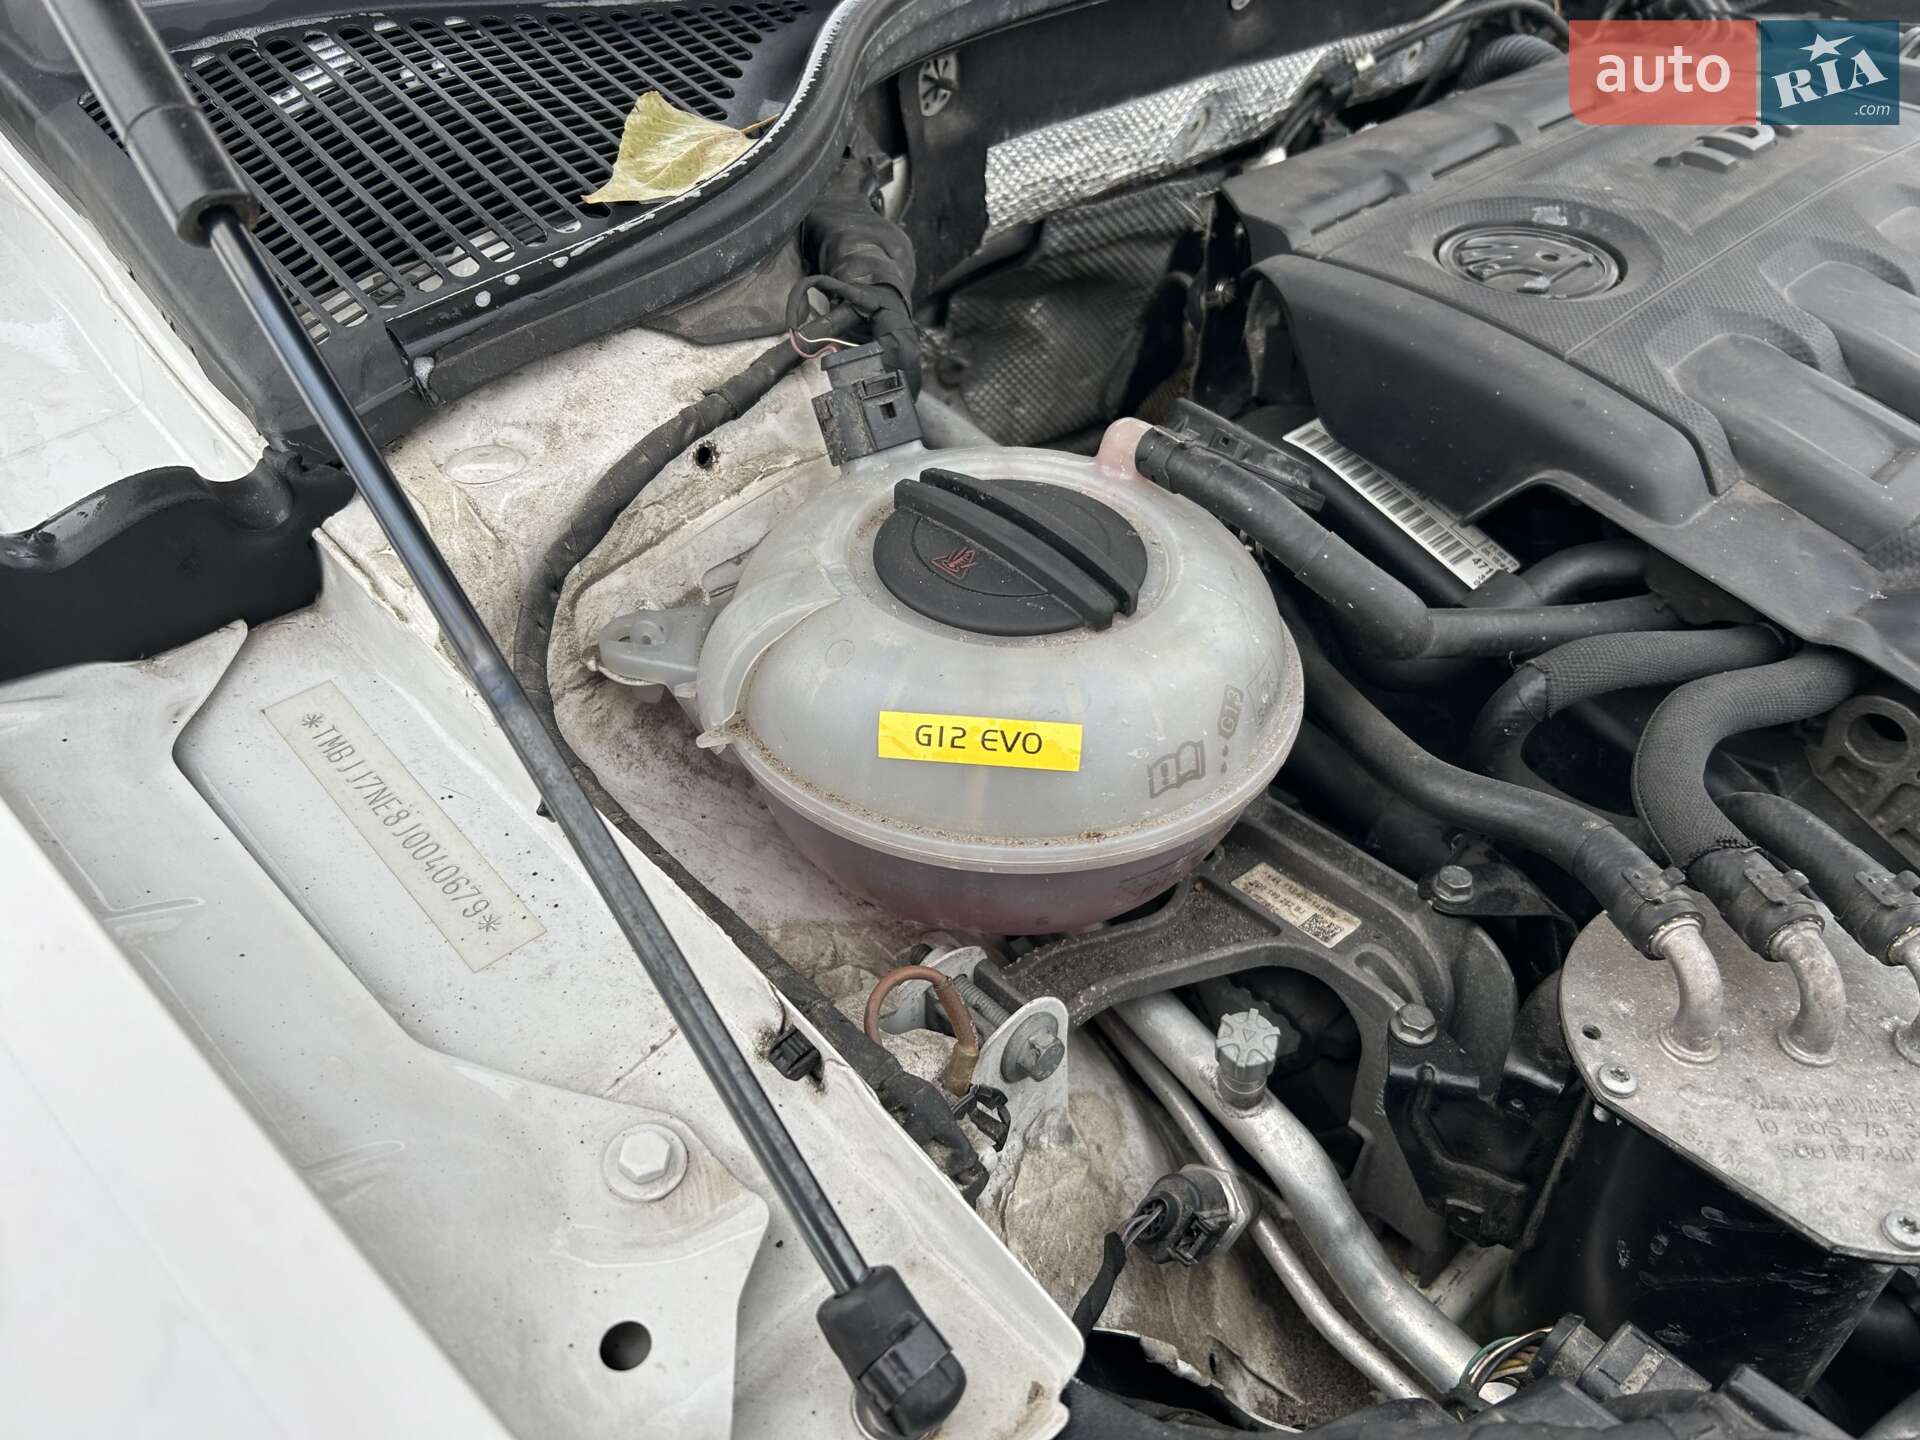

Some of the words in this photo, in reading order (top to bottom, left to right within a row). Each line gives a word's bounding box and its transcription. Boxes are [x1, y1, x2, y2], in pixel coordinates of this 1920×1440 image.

[1472, 557, 1494, 575] 471
[914, 724, 967, 749] G12
[980, 729, 1043, 755] EVO
